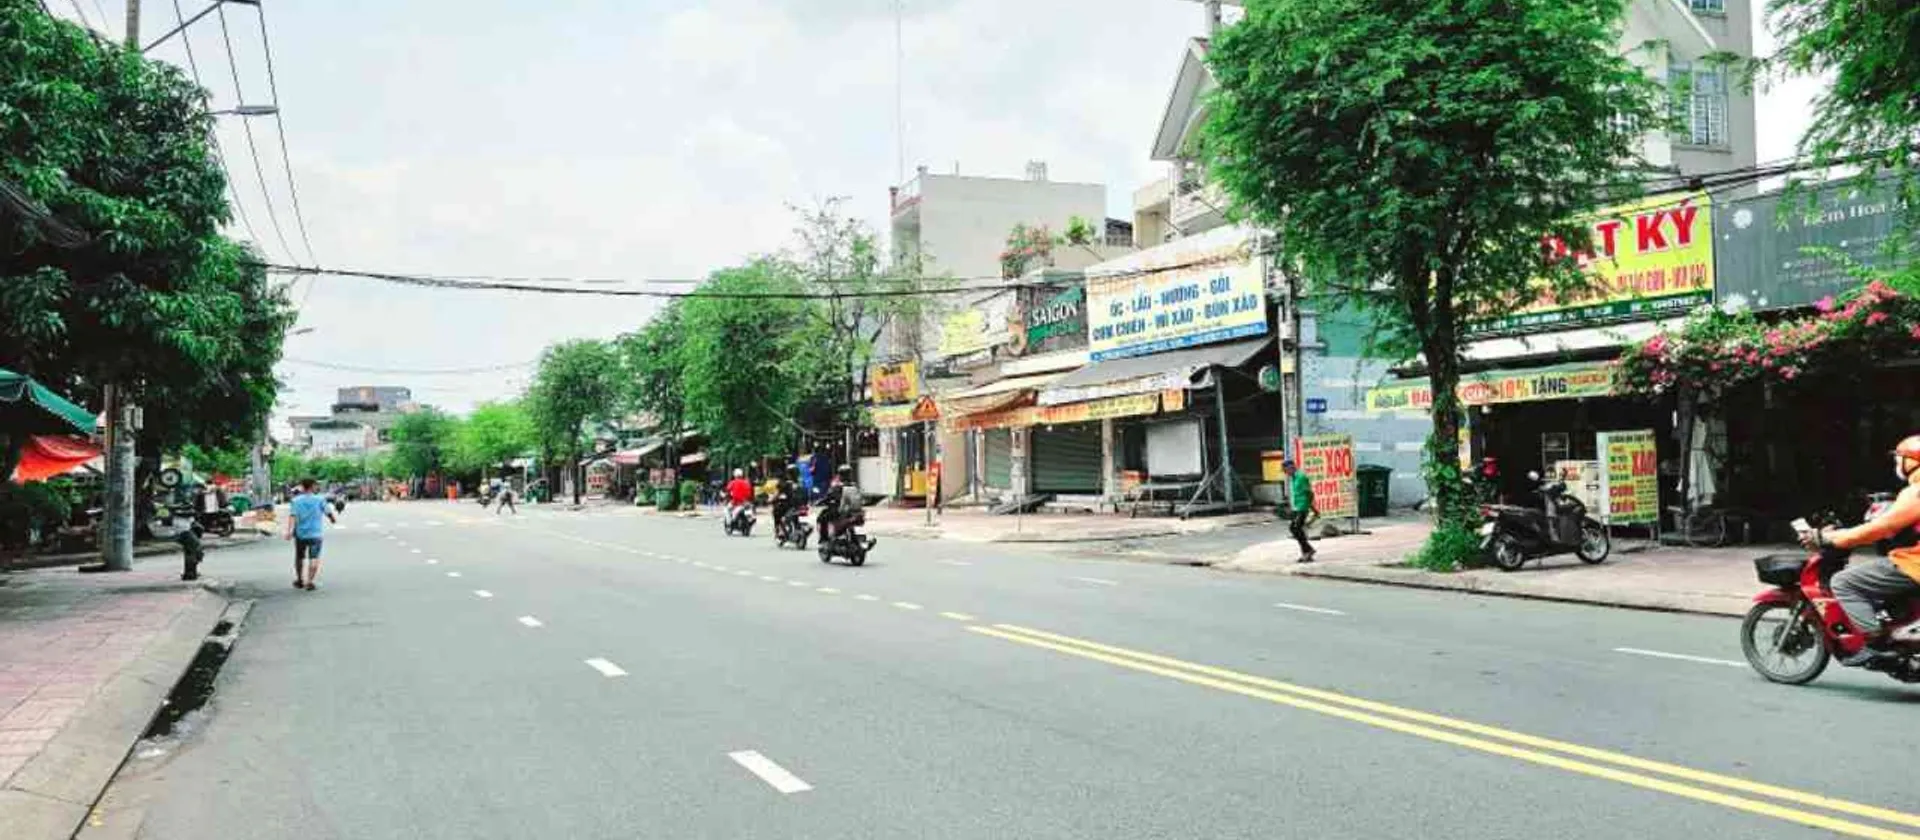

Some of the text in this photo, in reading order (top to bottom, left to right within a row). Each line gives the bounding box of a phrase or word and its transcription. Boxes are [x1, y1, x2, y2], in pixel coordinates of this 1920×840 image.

[1637, 198, 1698, 252] KÝ
[1031, 301, 1079, 326] SAIGON
[1172, 307, 1194, 325] XÀO
[1232, 291, 1258, 313] XÀO
